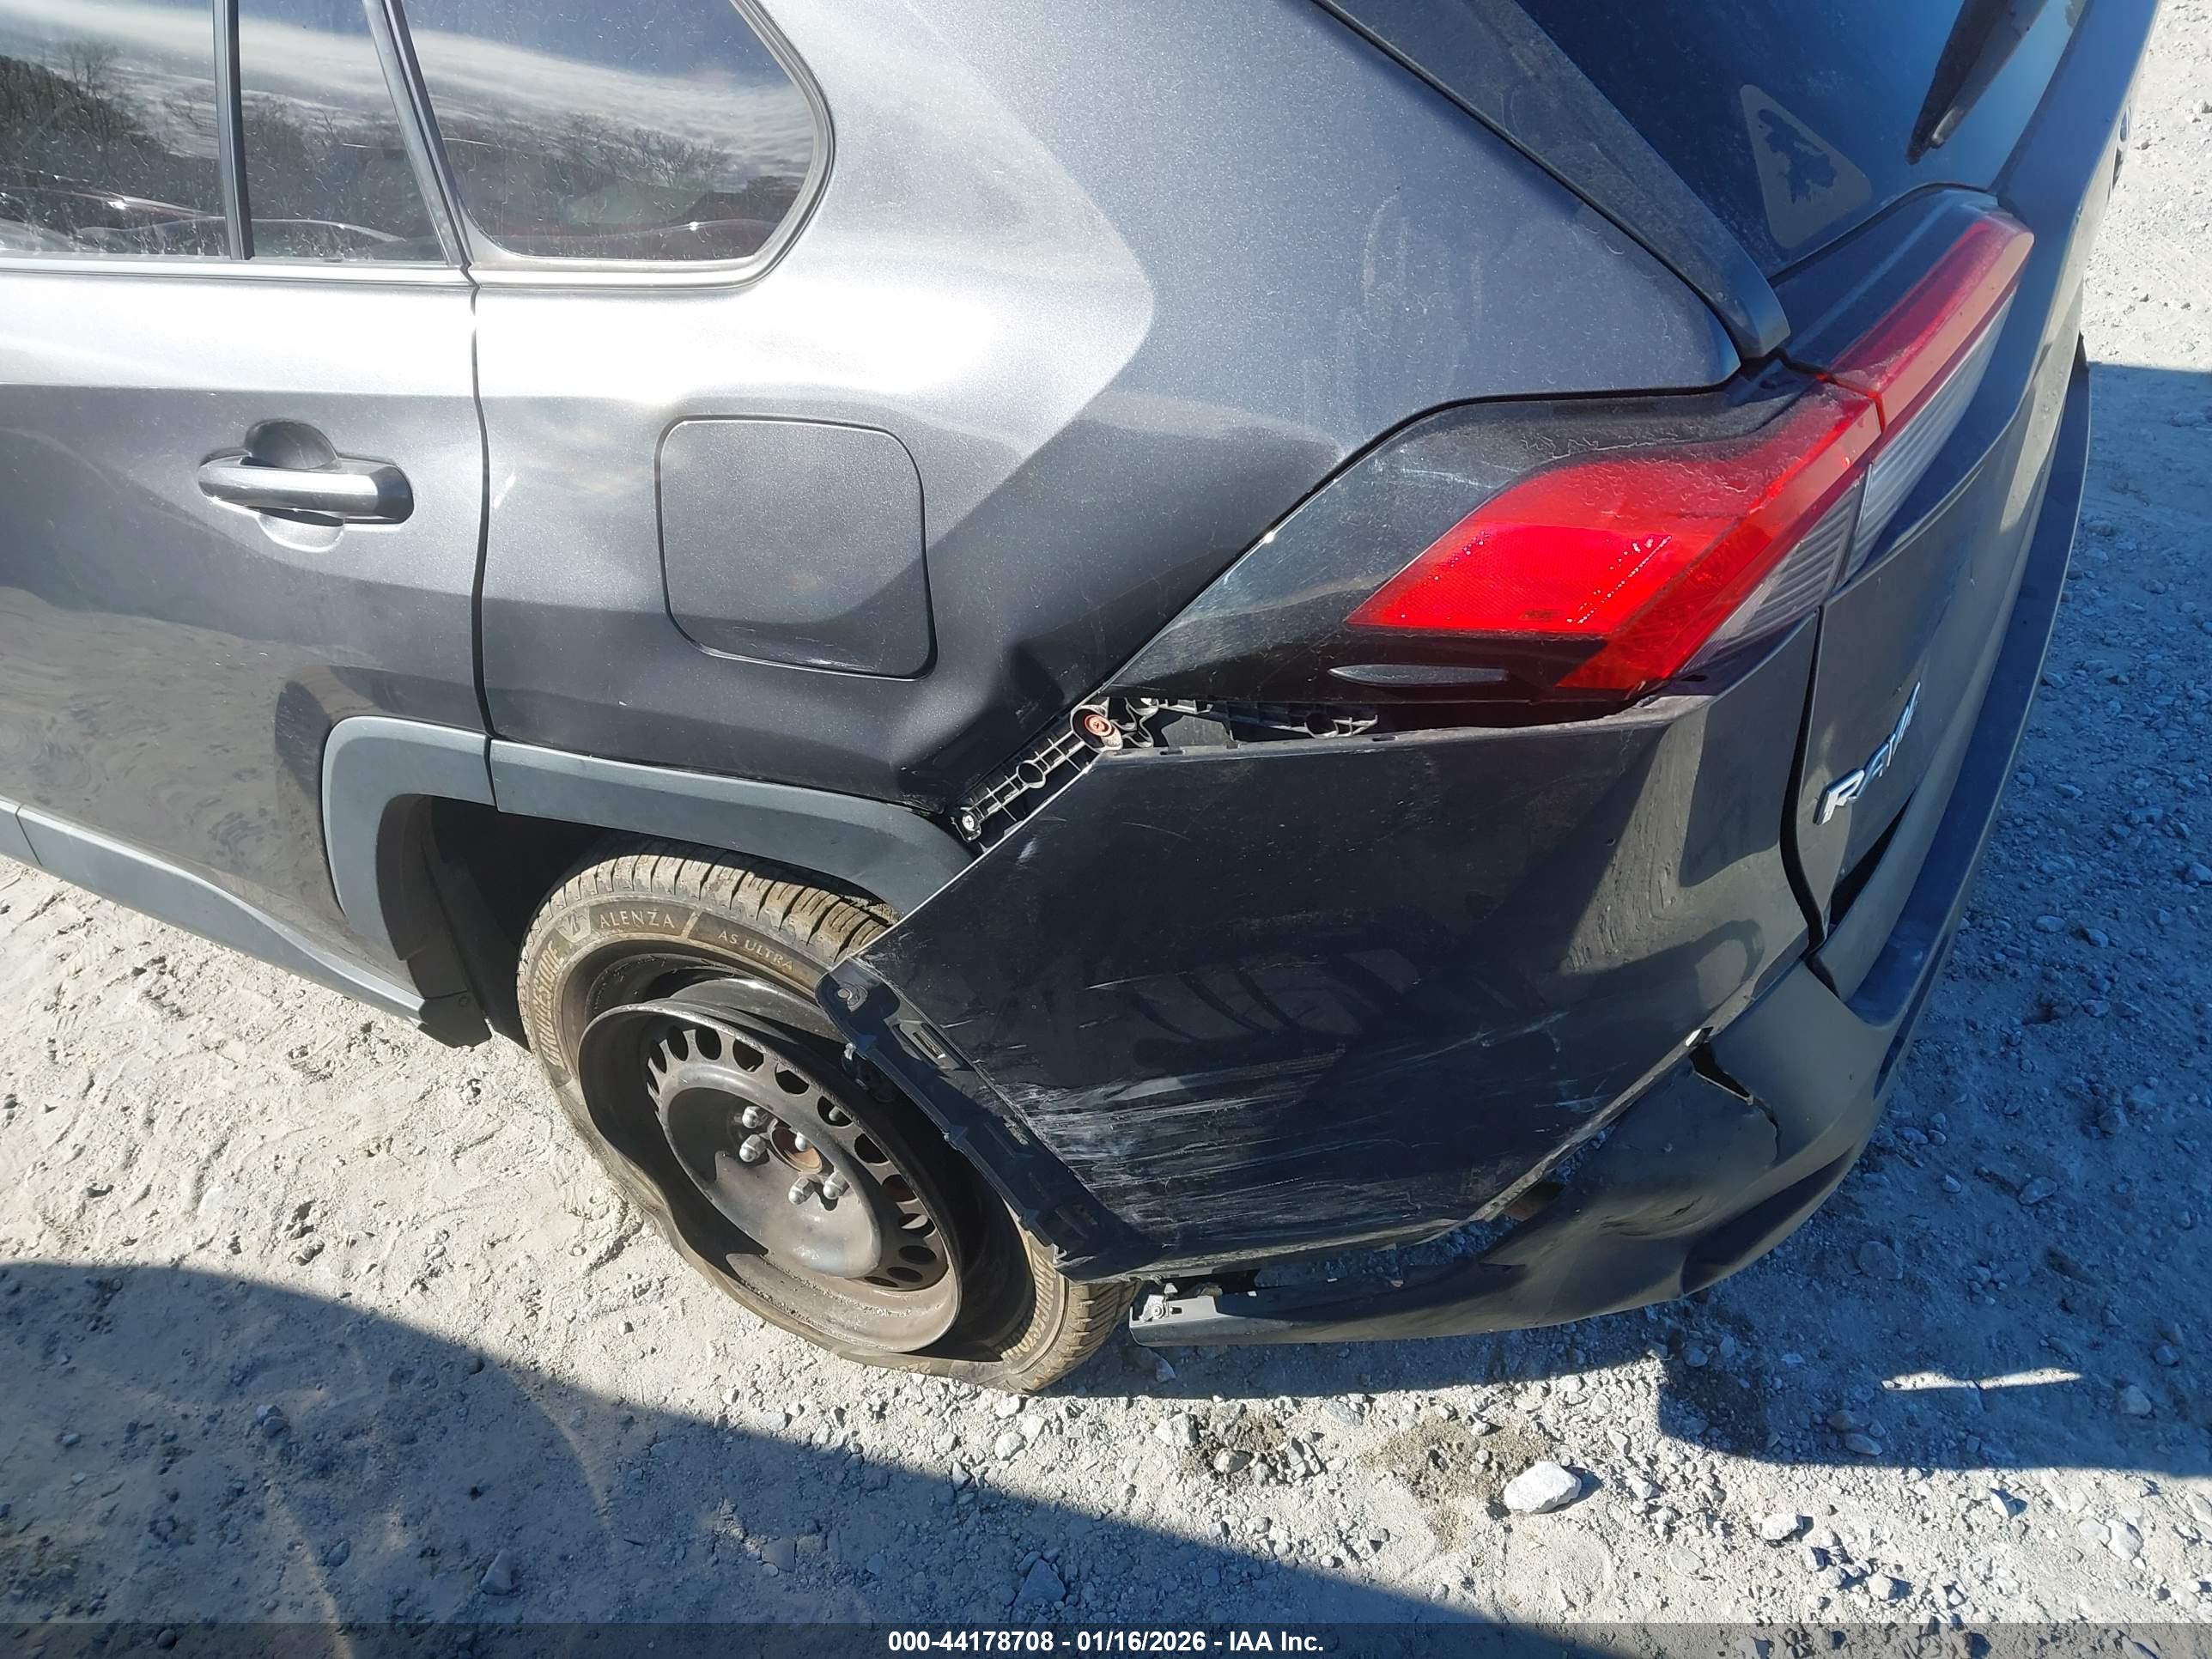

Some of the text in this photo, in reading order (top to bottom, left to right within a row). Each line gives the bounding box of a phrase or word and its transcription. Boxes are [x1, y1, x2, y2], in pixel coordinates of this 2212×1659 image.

[599, 909, 676, 929] ALENZA
[718, 929, 794, 973] AS ULTRA
[532, 939, 568, 1071] BRIDGESTONE
